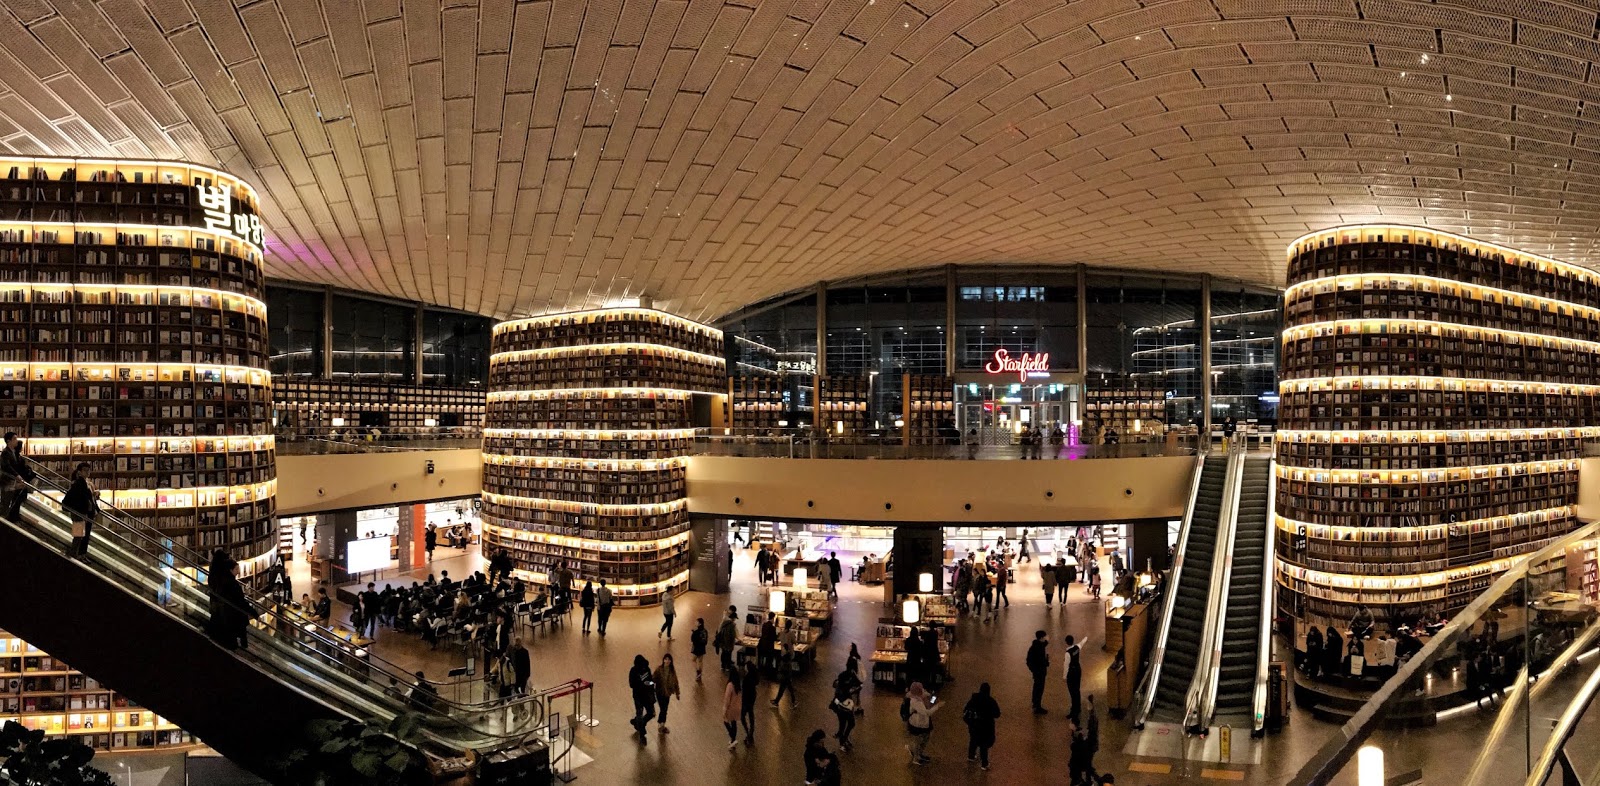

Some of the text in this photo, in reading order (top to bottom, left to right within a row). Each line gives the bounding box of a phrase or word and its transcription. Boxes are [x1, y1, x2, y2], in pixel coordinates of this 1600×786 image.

[986, 348, 1049, 383] Starfield
[1450, 514, 1456, 523] C
[1299, 526, 1306, 536] C
[275, 556, 283, 567] A
[274, 572, 284, 584] A
